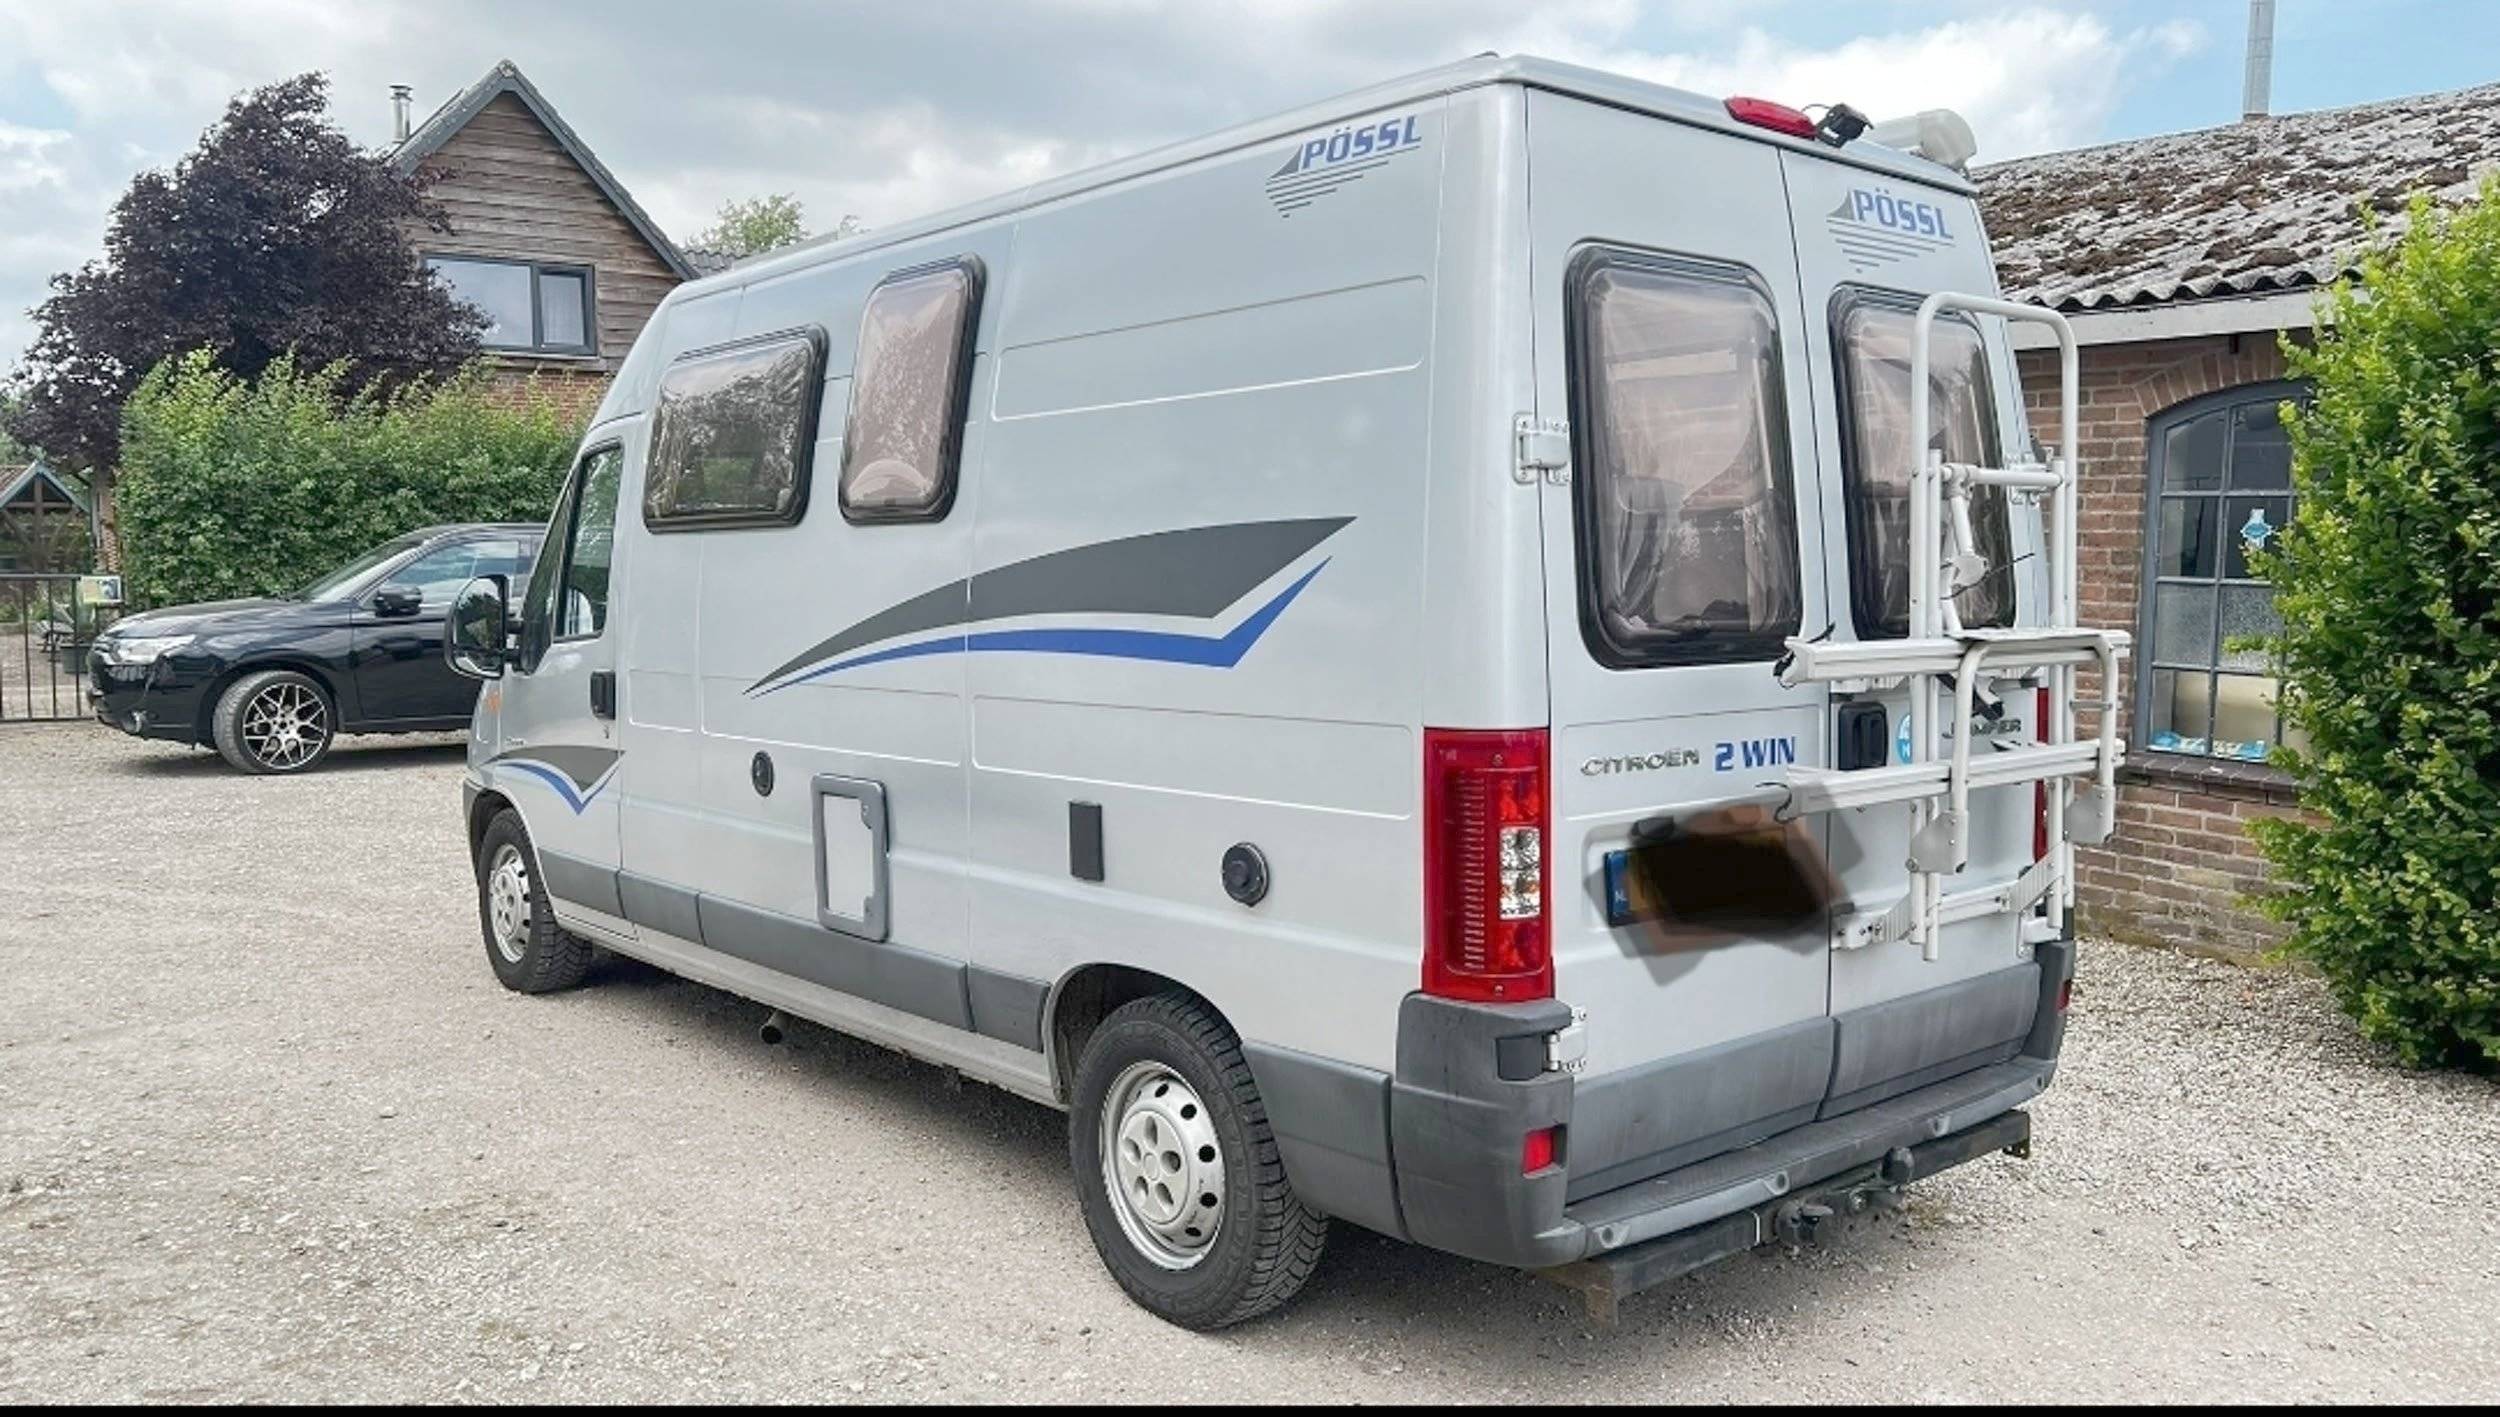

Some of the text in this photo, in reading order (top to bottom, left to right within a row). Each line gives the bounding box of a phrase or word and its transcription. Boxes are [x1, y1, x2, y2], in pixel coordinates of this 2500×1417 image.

[1302, 115, 1422, 169] PÖSSL
[1853, 187, 1954, 239] PÖSSL
[1715, 736, 1795, 771] 2 WIN
